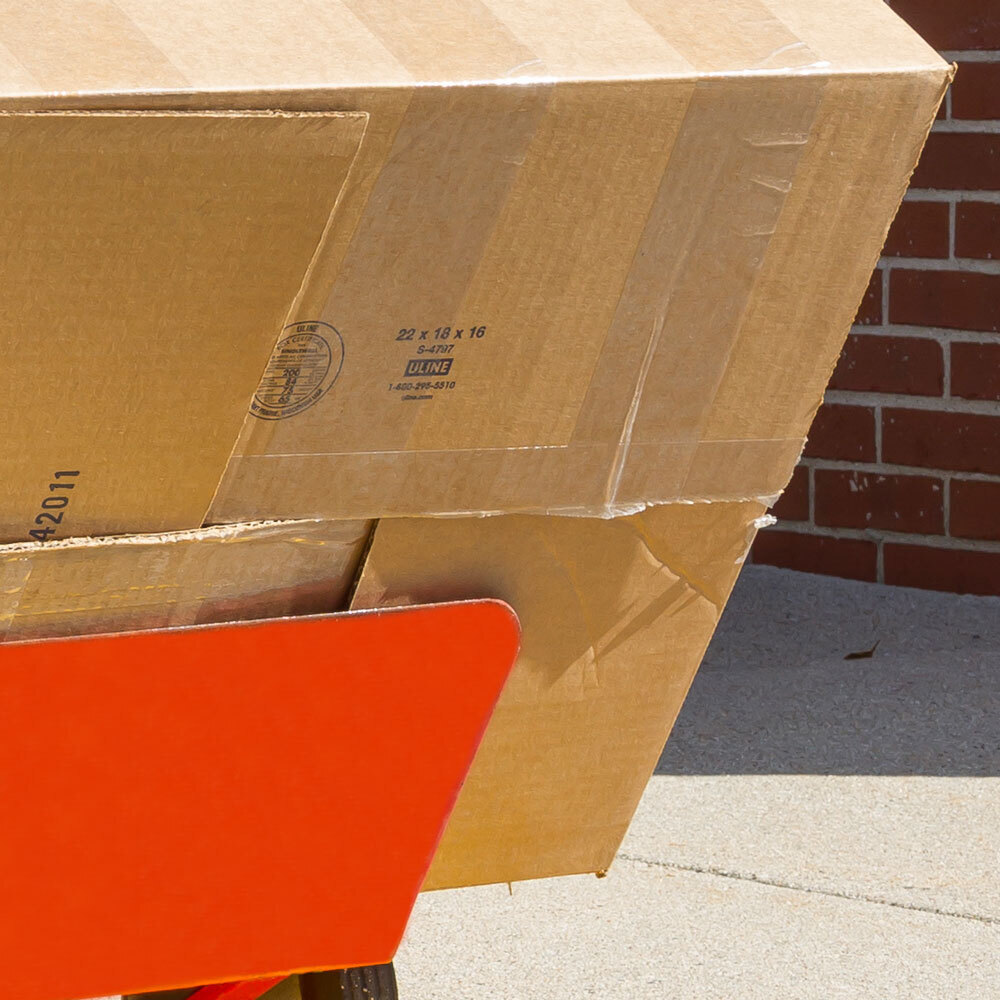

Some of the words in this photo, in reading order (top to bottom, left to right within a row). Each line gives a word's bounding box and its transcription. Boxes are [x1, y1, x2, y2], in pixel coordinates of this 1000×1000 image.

[395, 328, 416, 341] 22
[419, 330, 429, 340] x
[434, 327, 451, 340] 18
[454, 329, 464, 340] x
[469, 326, 486, 339] 16
[407, 360, 451, 375] ULINE
